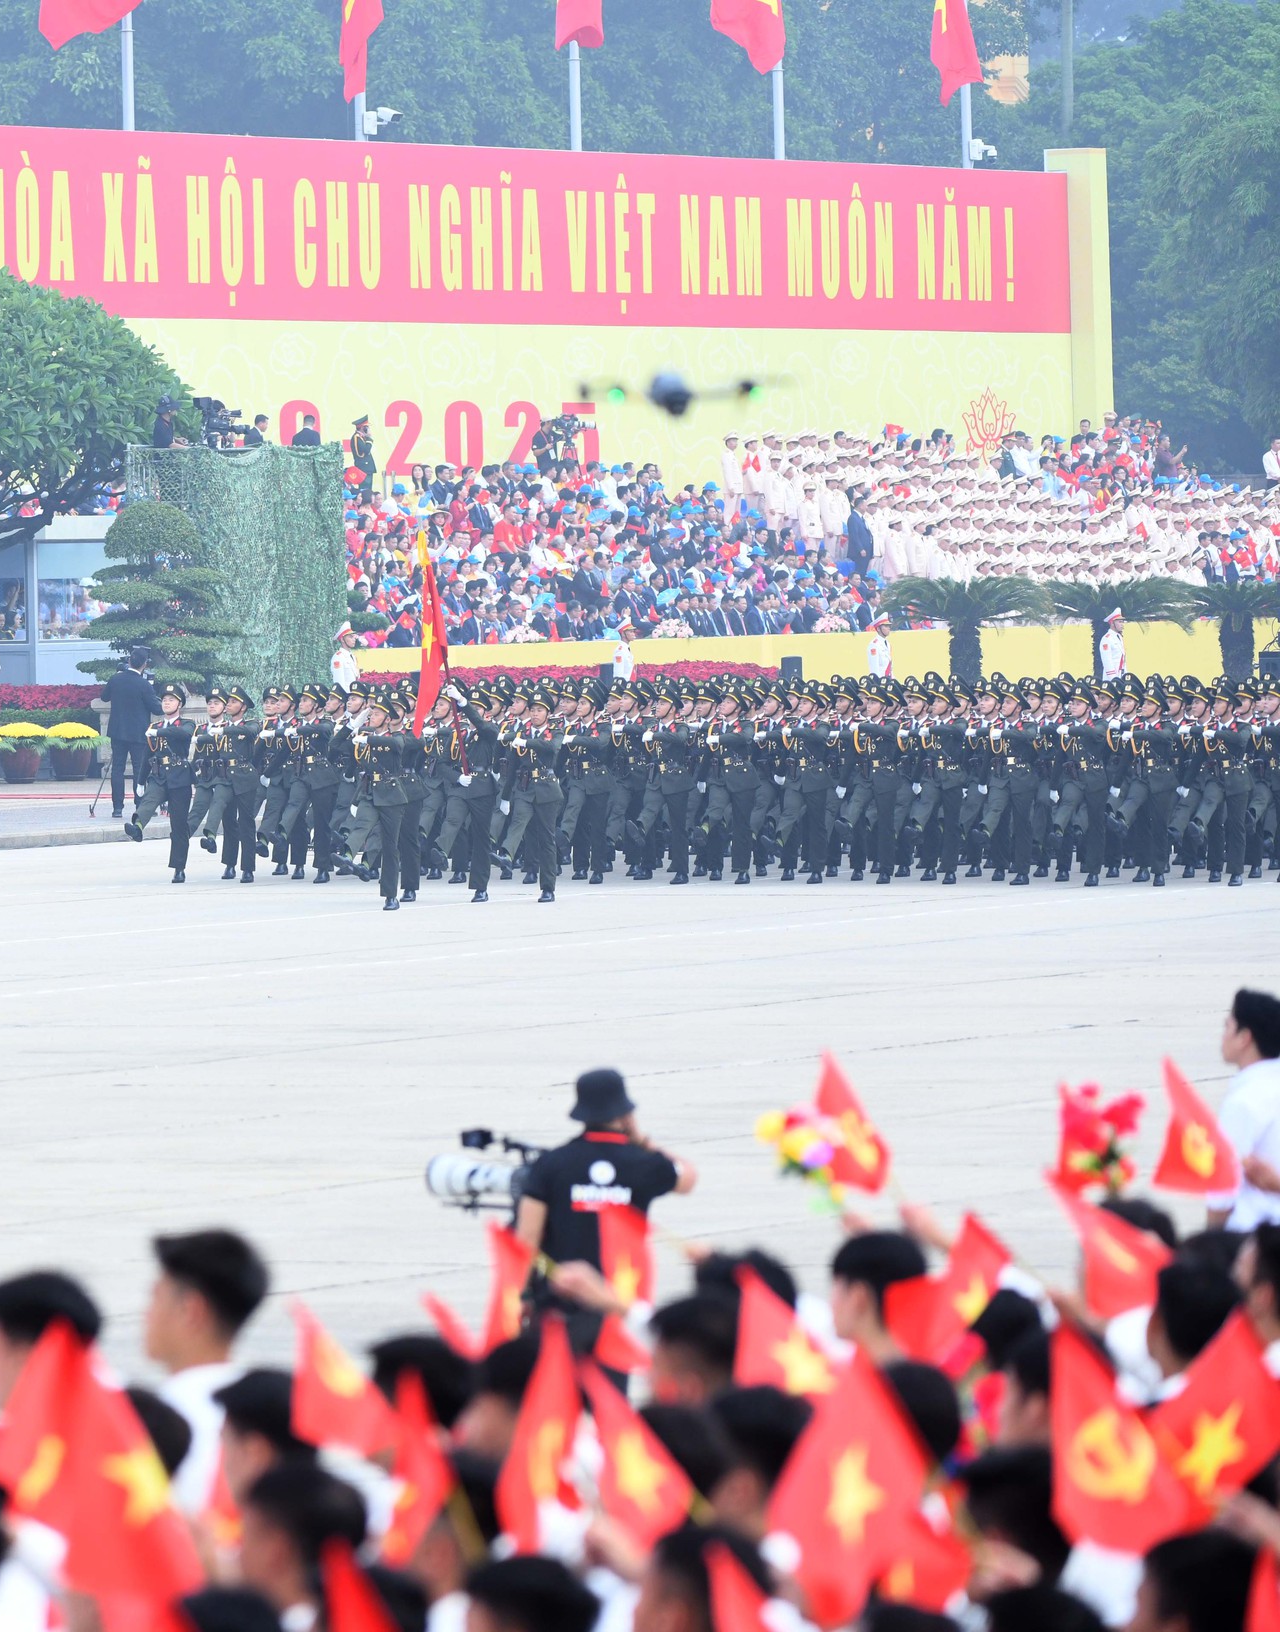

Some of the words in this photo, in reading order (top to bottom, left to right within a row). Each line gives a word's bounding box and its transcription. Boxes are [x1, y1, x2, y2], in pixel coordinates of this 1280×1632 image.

[103, 156, 159, 284] XÃ
[186, 157, 266, 307] HỘI
[294, 155, 381, 290] CHỦ
[408, 171, 544, 293] NGHĨA
[565, 173, 656, 315] VIỆT
[680, 195, 763, 297] NAM
[786, 182, 895, 300] MUÔN
